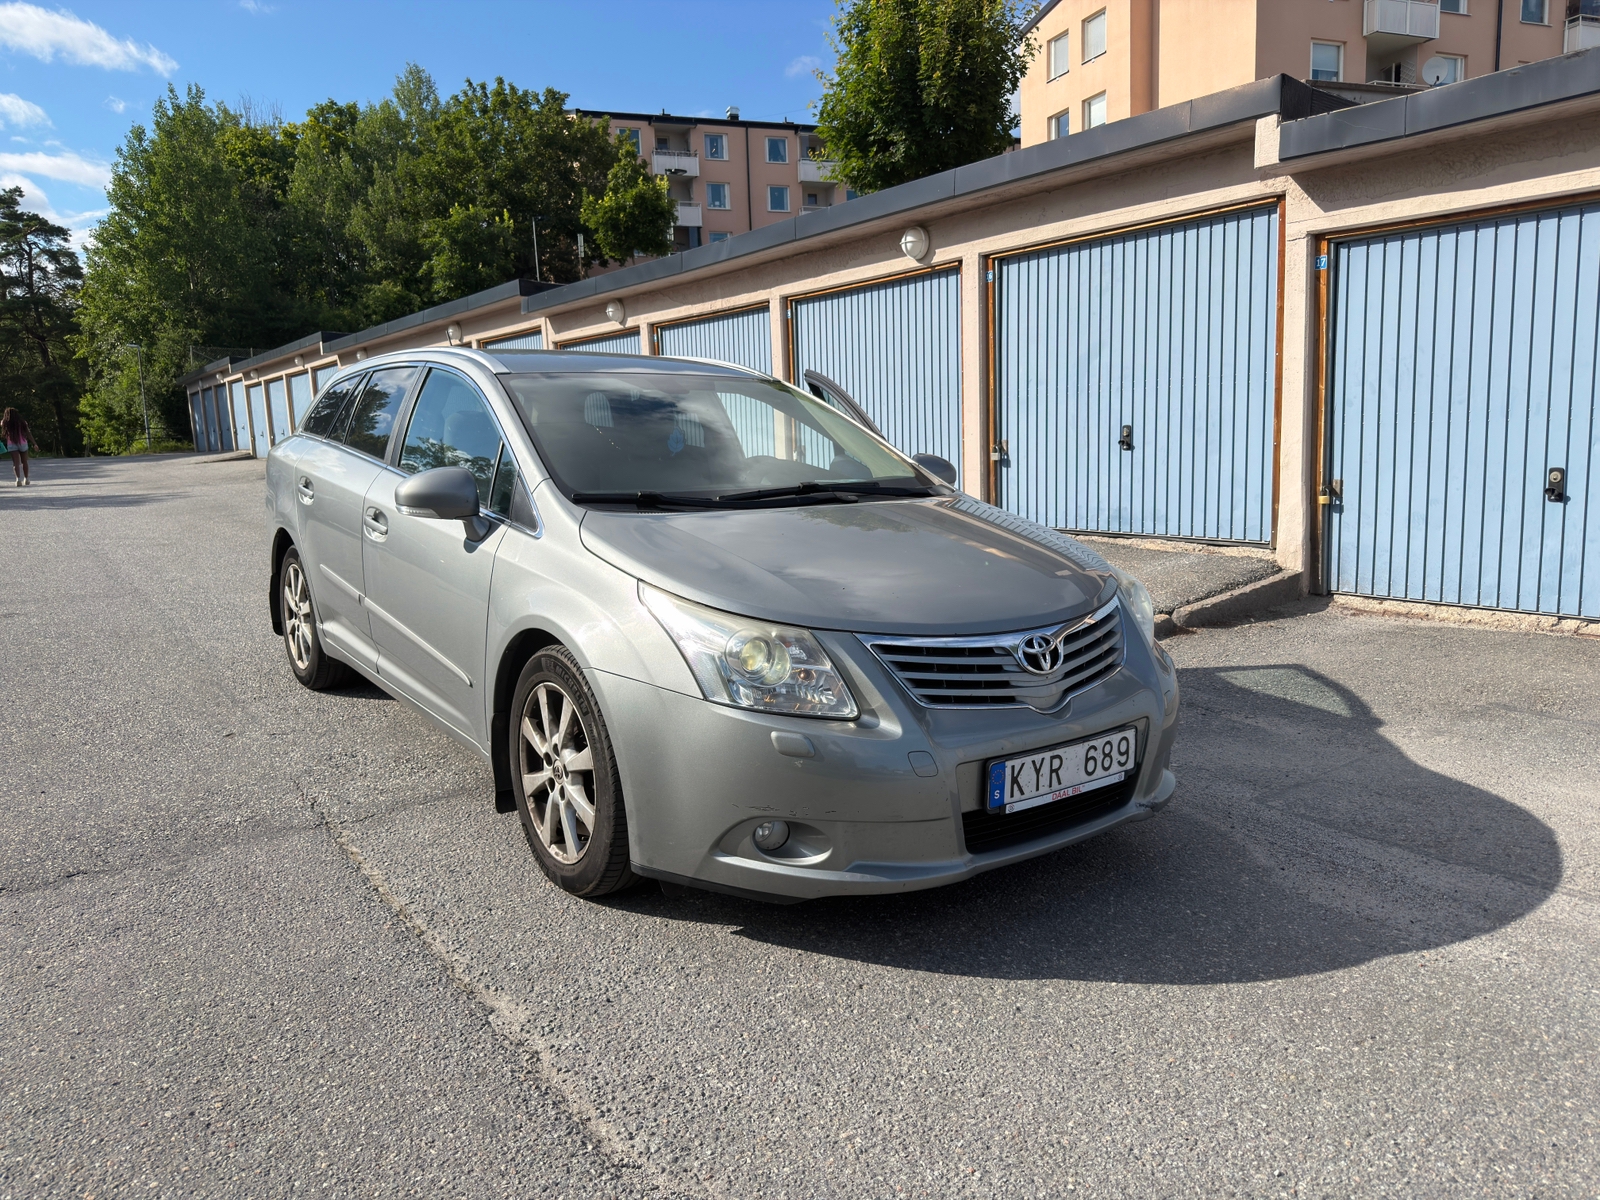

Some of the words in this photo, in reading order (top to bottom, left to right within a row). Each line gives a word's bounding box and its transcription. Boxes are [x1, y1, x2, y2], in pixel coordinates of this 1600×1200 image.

[1316, 257, 1326, 267] 17
[555, 666, 589, 715] MICHELIN
[1010, 754, 1064, 798] KYR
[1084, 736, 1130, 776] 689
[994, 790, 1000, 799] S
[1051, 790, 1070, 801] DAAL
